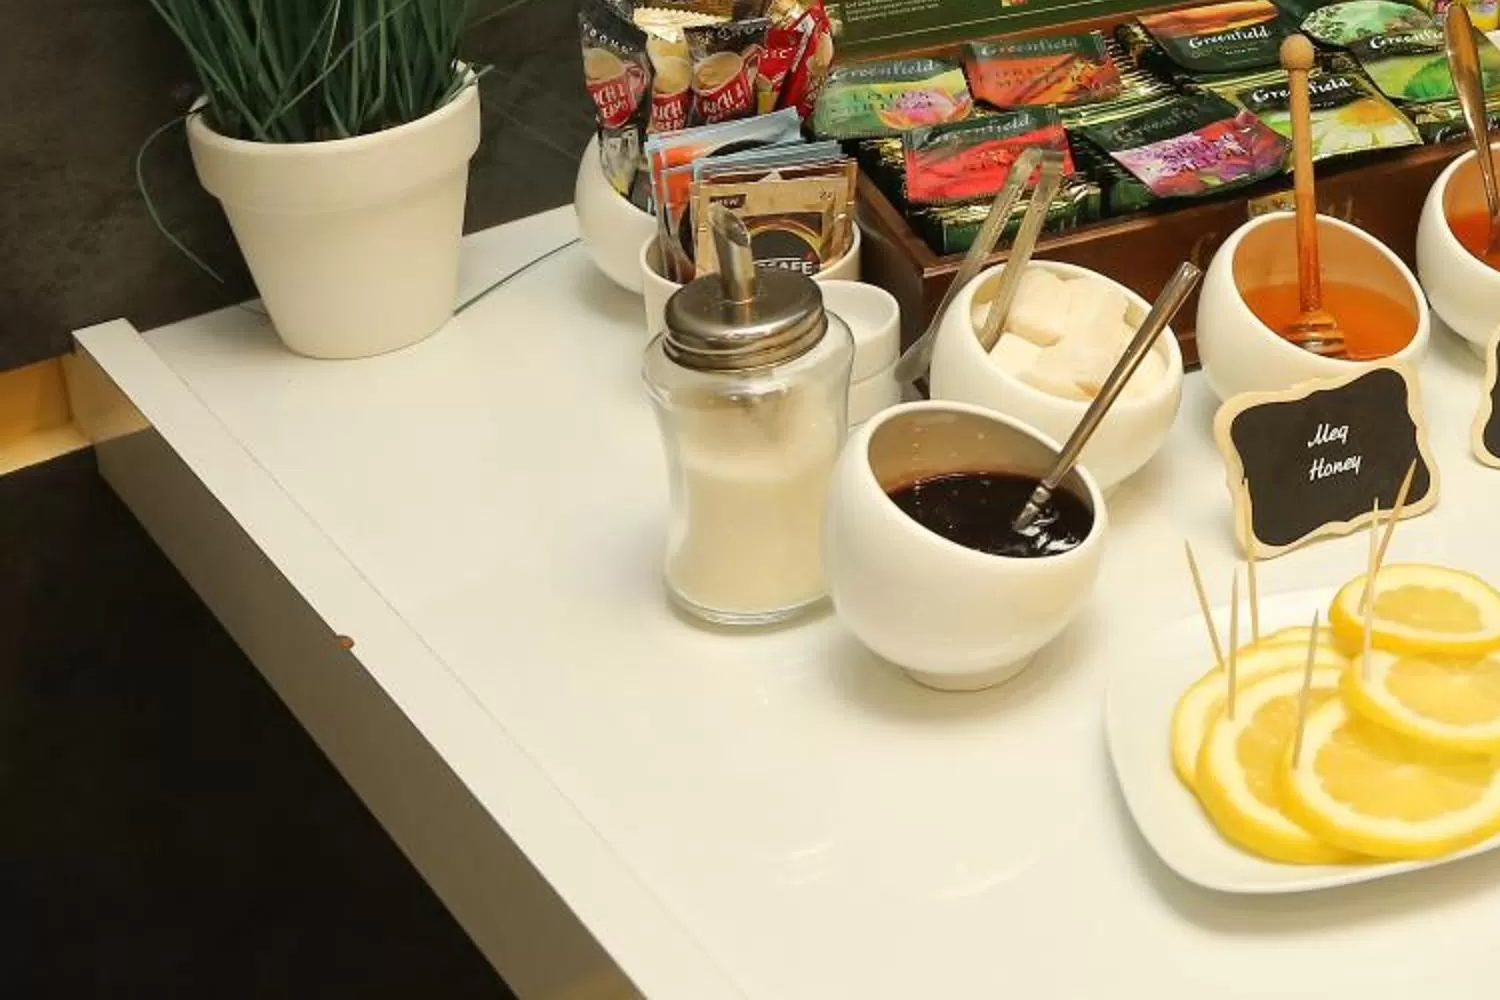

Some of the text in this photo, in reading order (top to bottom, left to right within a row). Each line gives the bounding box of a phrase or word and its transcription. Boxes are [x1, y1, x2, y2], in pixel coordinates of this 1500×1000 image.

[1188, 25, 1270, 49] Greenfield
[1369, 29, 1444, 49] Greenfi
[1252, 77, 1351, 103] Grefield
[1307, 423, 1349, 448] Мед
[1309, 455, 1362, 481] Honey
